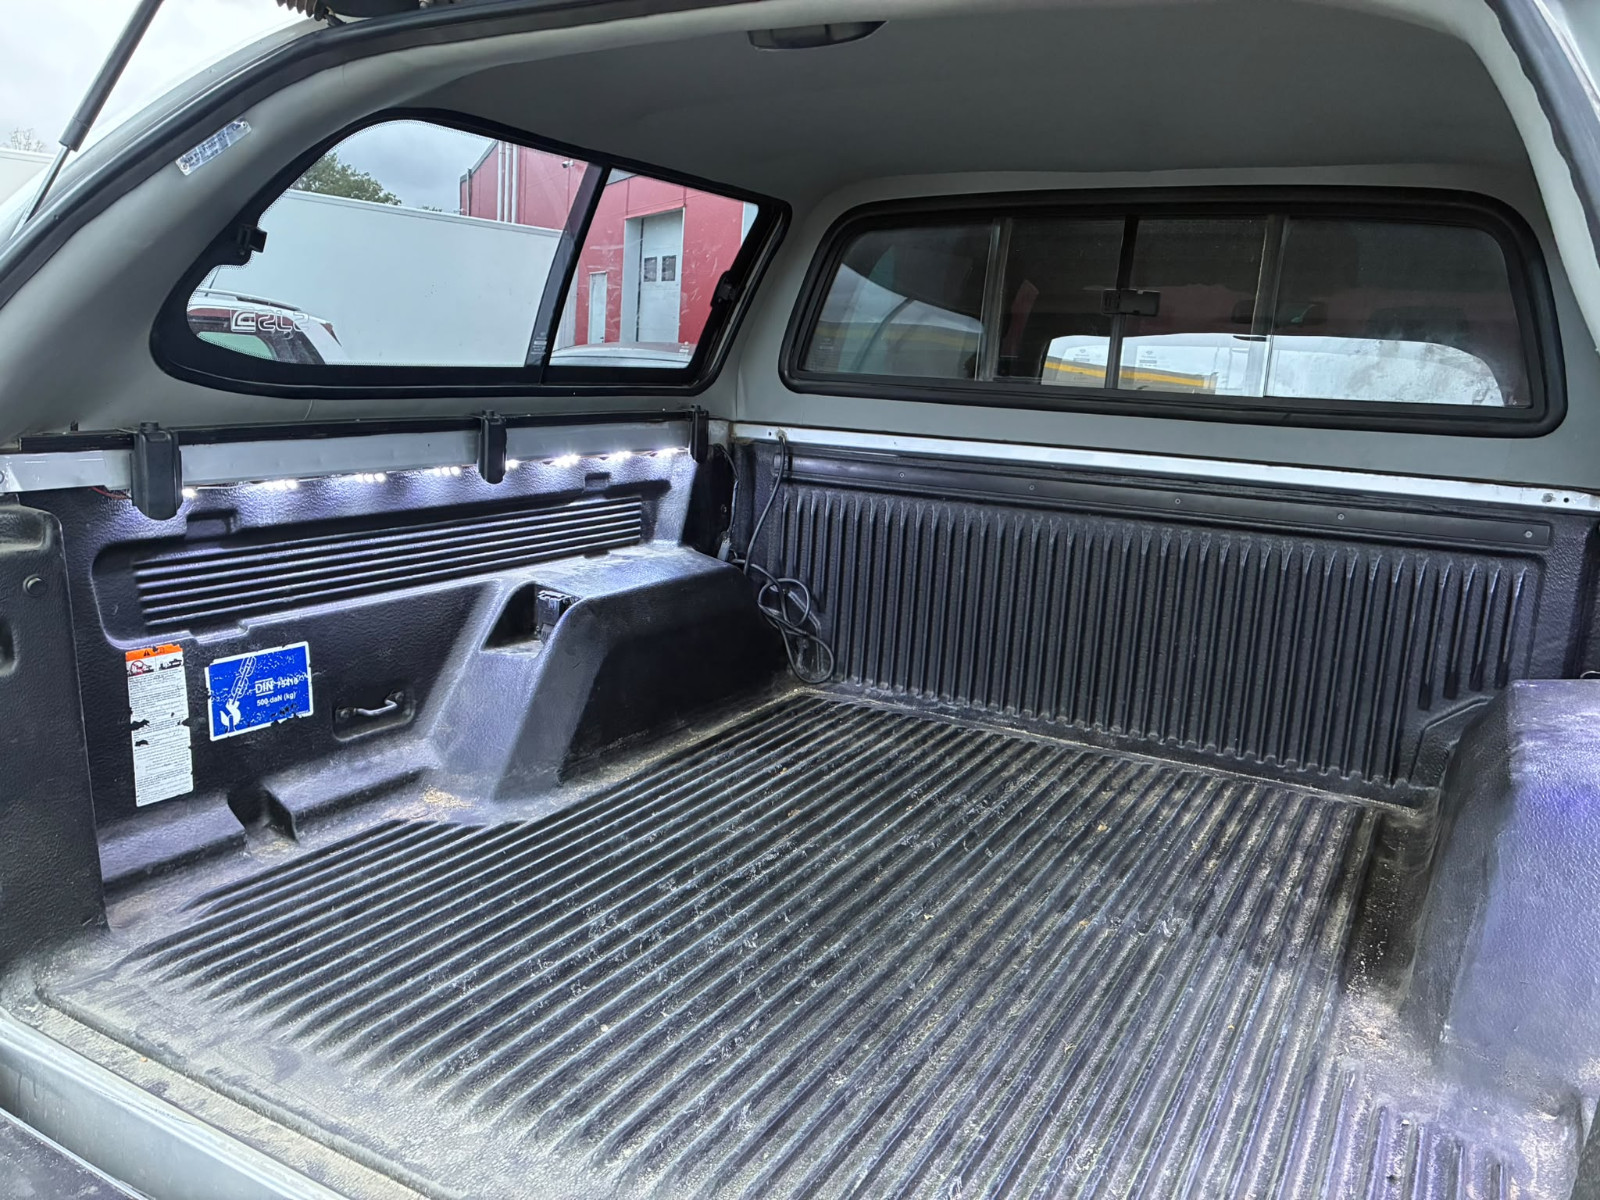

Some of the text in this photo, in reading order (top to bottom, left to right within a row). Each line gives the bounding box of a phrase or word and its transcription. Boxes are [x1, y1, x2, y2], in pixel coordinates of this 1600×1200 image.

[255, 679, 274, 694] DIN
[256, 691, 296, 706] 500 daN (kg)
